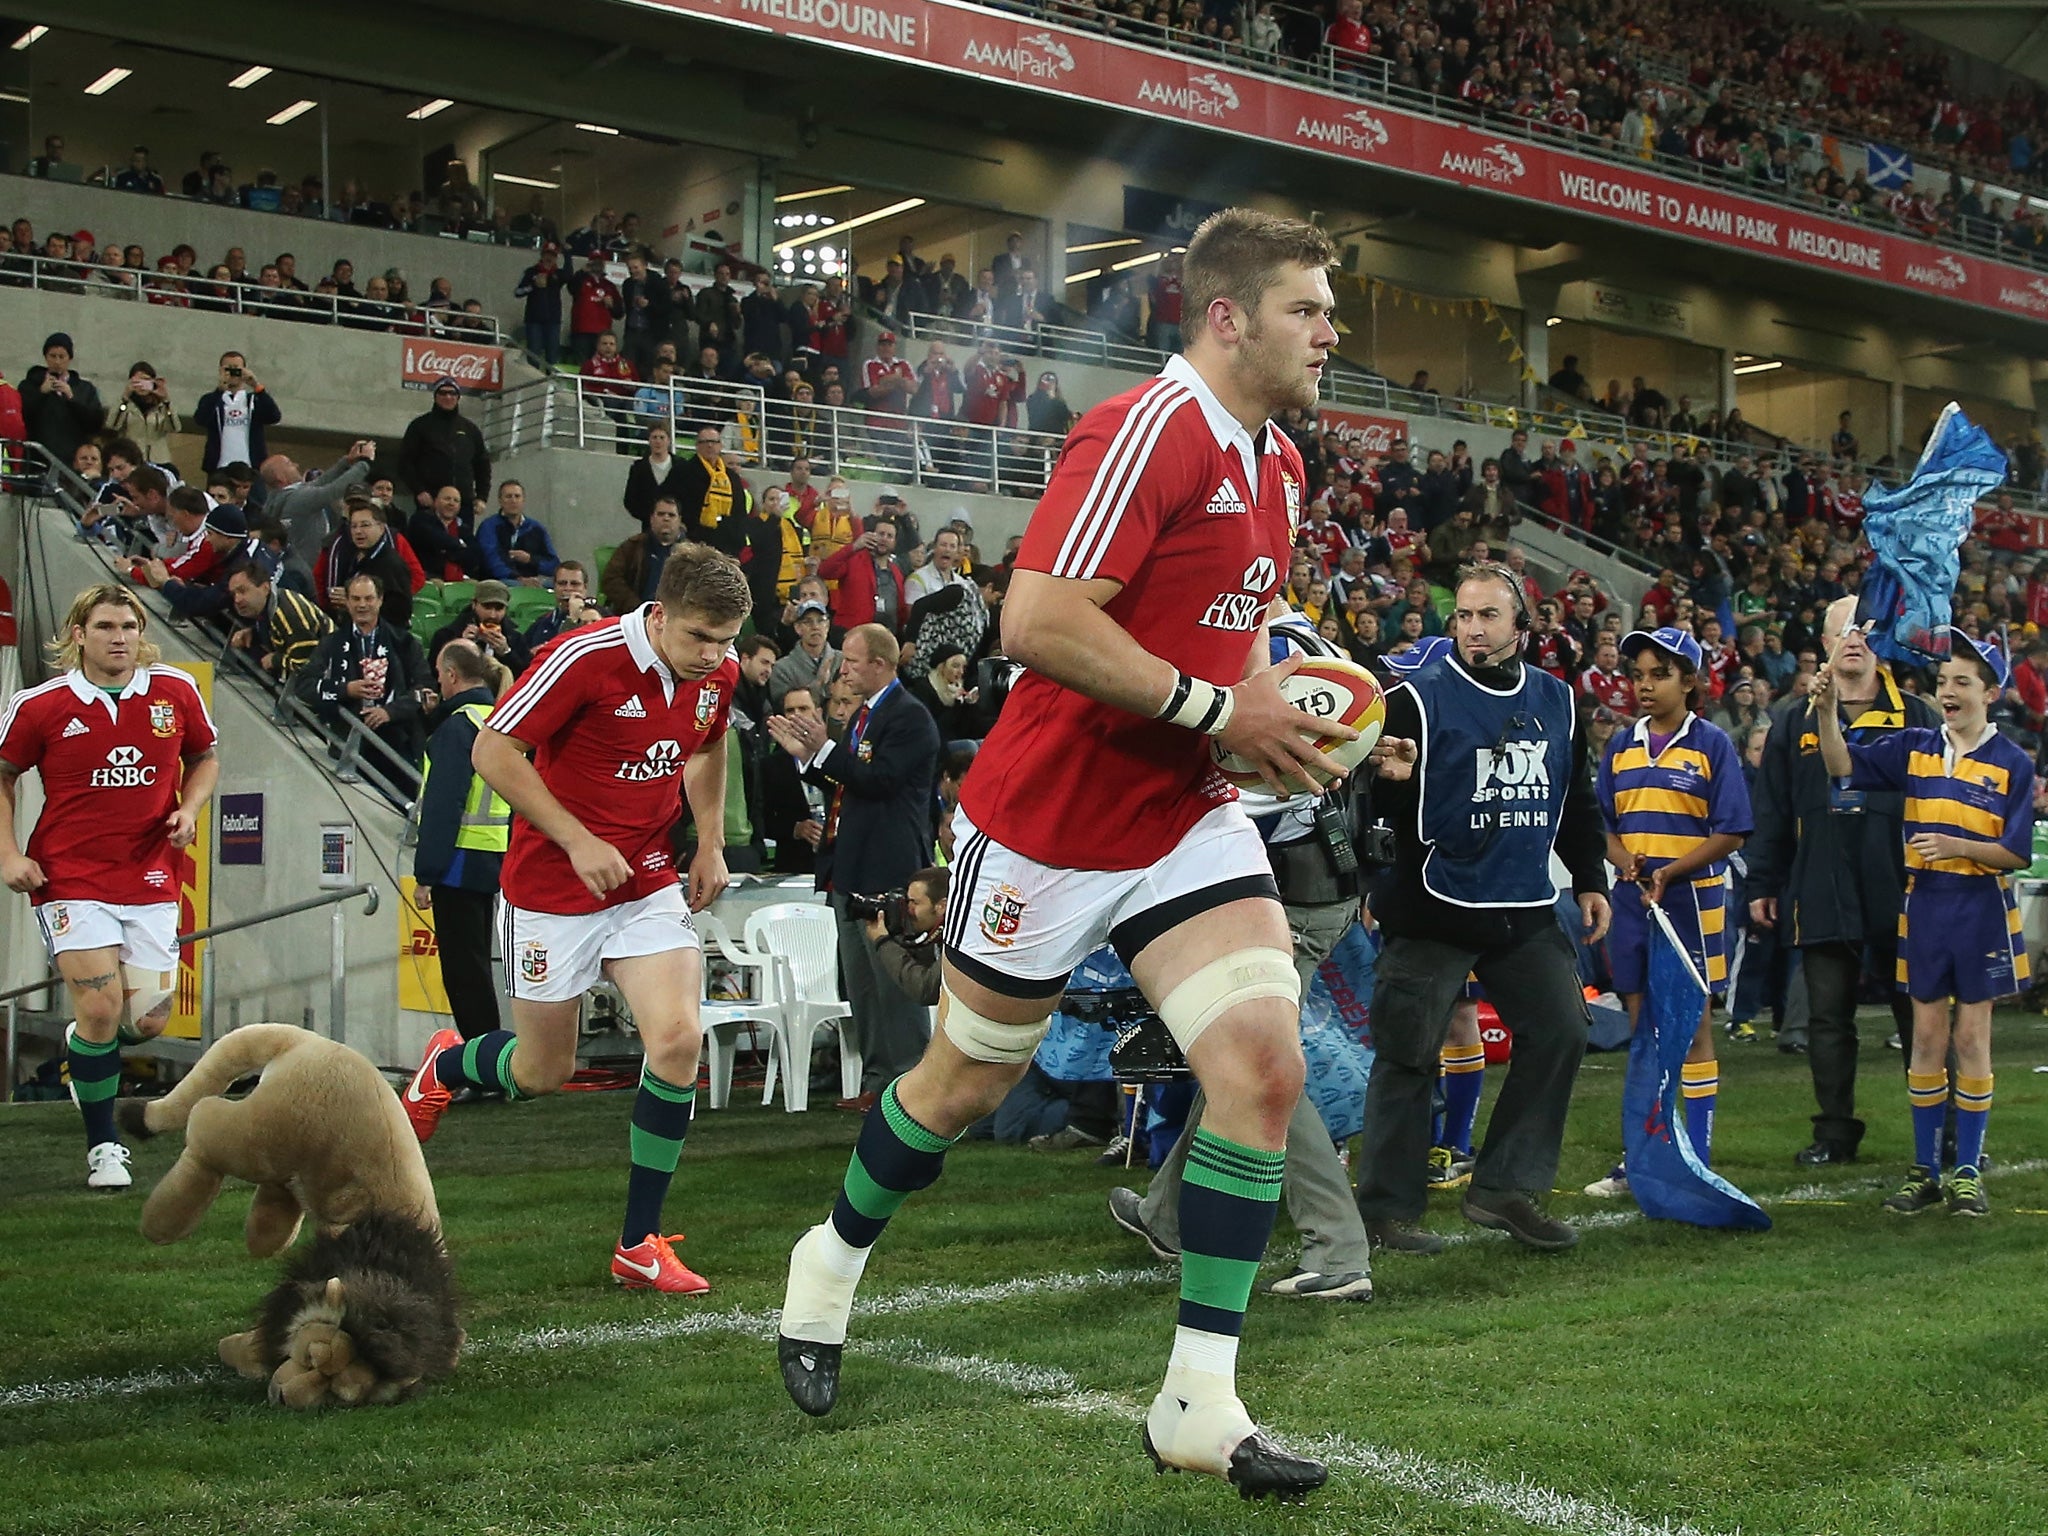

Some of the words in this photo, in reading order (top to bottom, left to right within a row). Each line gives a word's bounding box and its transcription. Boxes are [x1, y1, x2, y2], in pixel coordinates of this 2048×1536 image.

[1559, 169, 1652, 216] WELCOME
[1657, 195, 1681, 223] TO
[1685, 203, 1732, 236] AAMI
[1736, 214, 1779, 246] PARK
[1787, 227, 1881, 271] MELBOURNE
[1205, 501, 1247, 514] adidas
[614, 707, 647, 719] adidas
[89, 765, 157, 787] HSBC
[1471, 785, 1550, 803] SPORTS
[222, 813, 259, 832] RaboDirect
[1513, 811, 1531, 827] IN
[1113, 1024, 1143, 1055] STEADICAM
